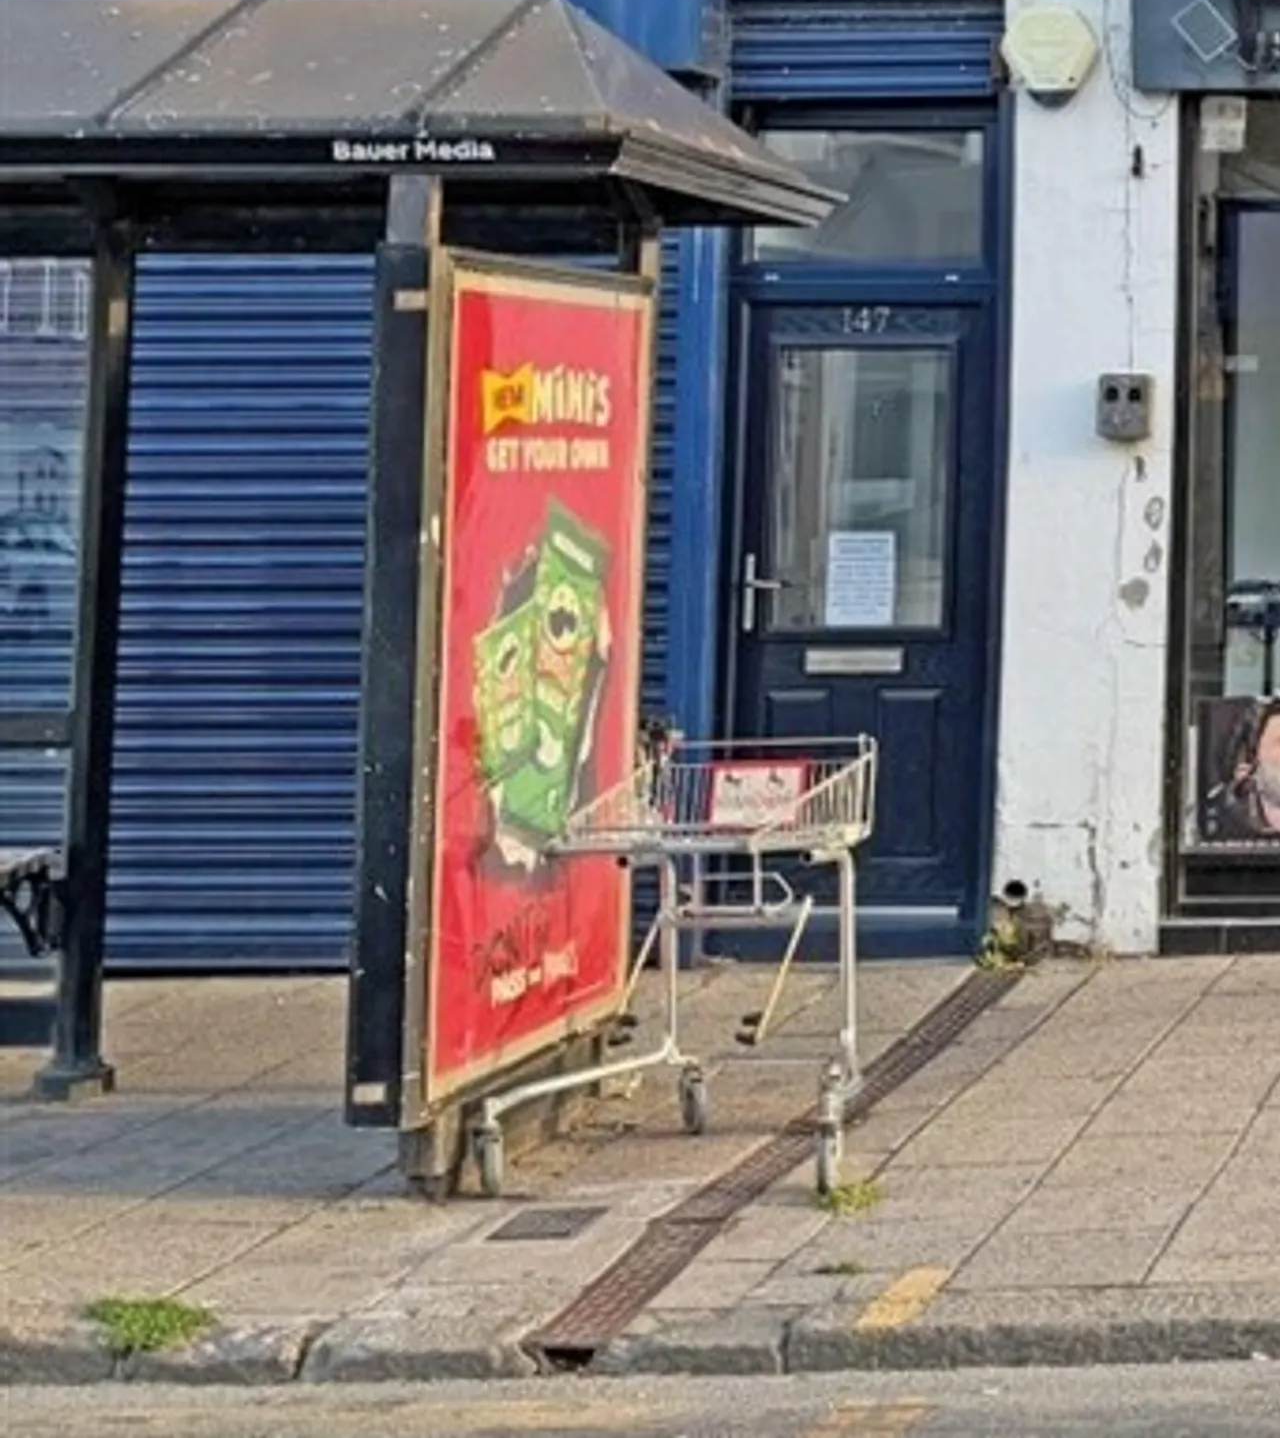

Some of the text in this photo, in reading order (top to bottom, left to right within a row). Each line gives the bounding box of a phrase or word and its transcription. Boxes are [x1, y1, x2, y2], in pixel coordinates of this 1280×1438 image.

[333, 139, 496, 162] Bauer Media
[841, 307, 891, 334] 147
